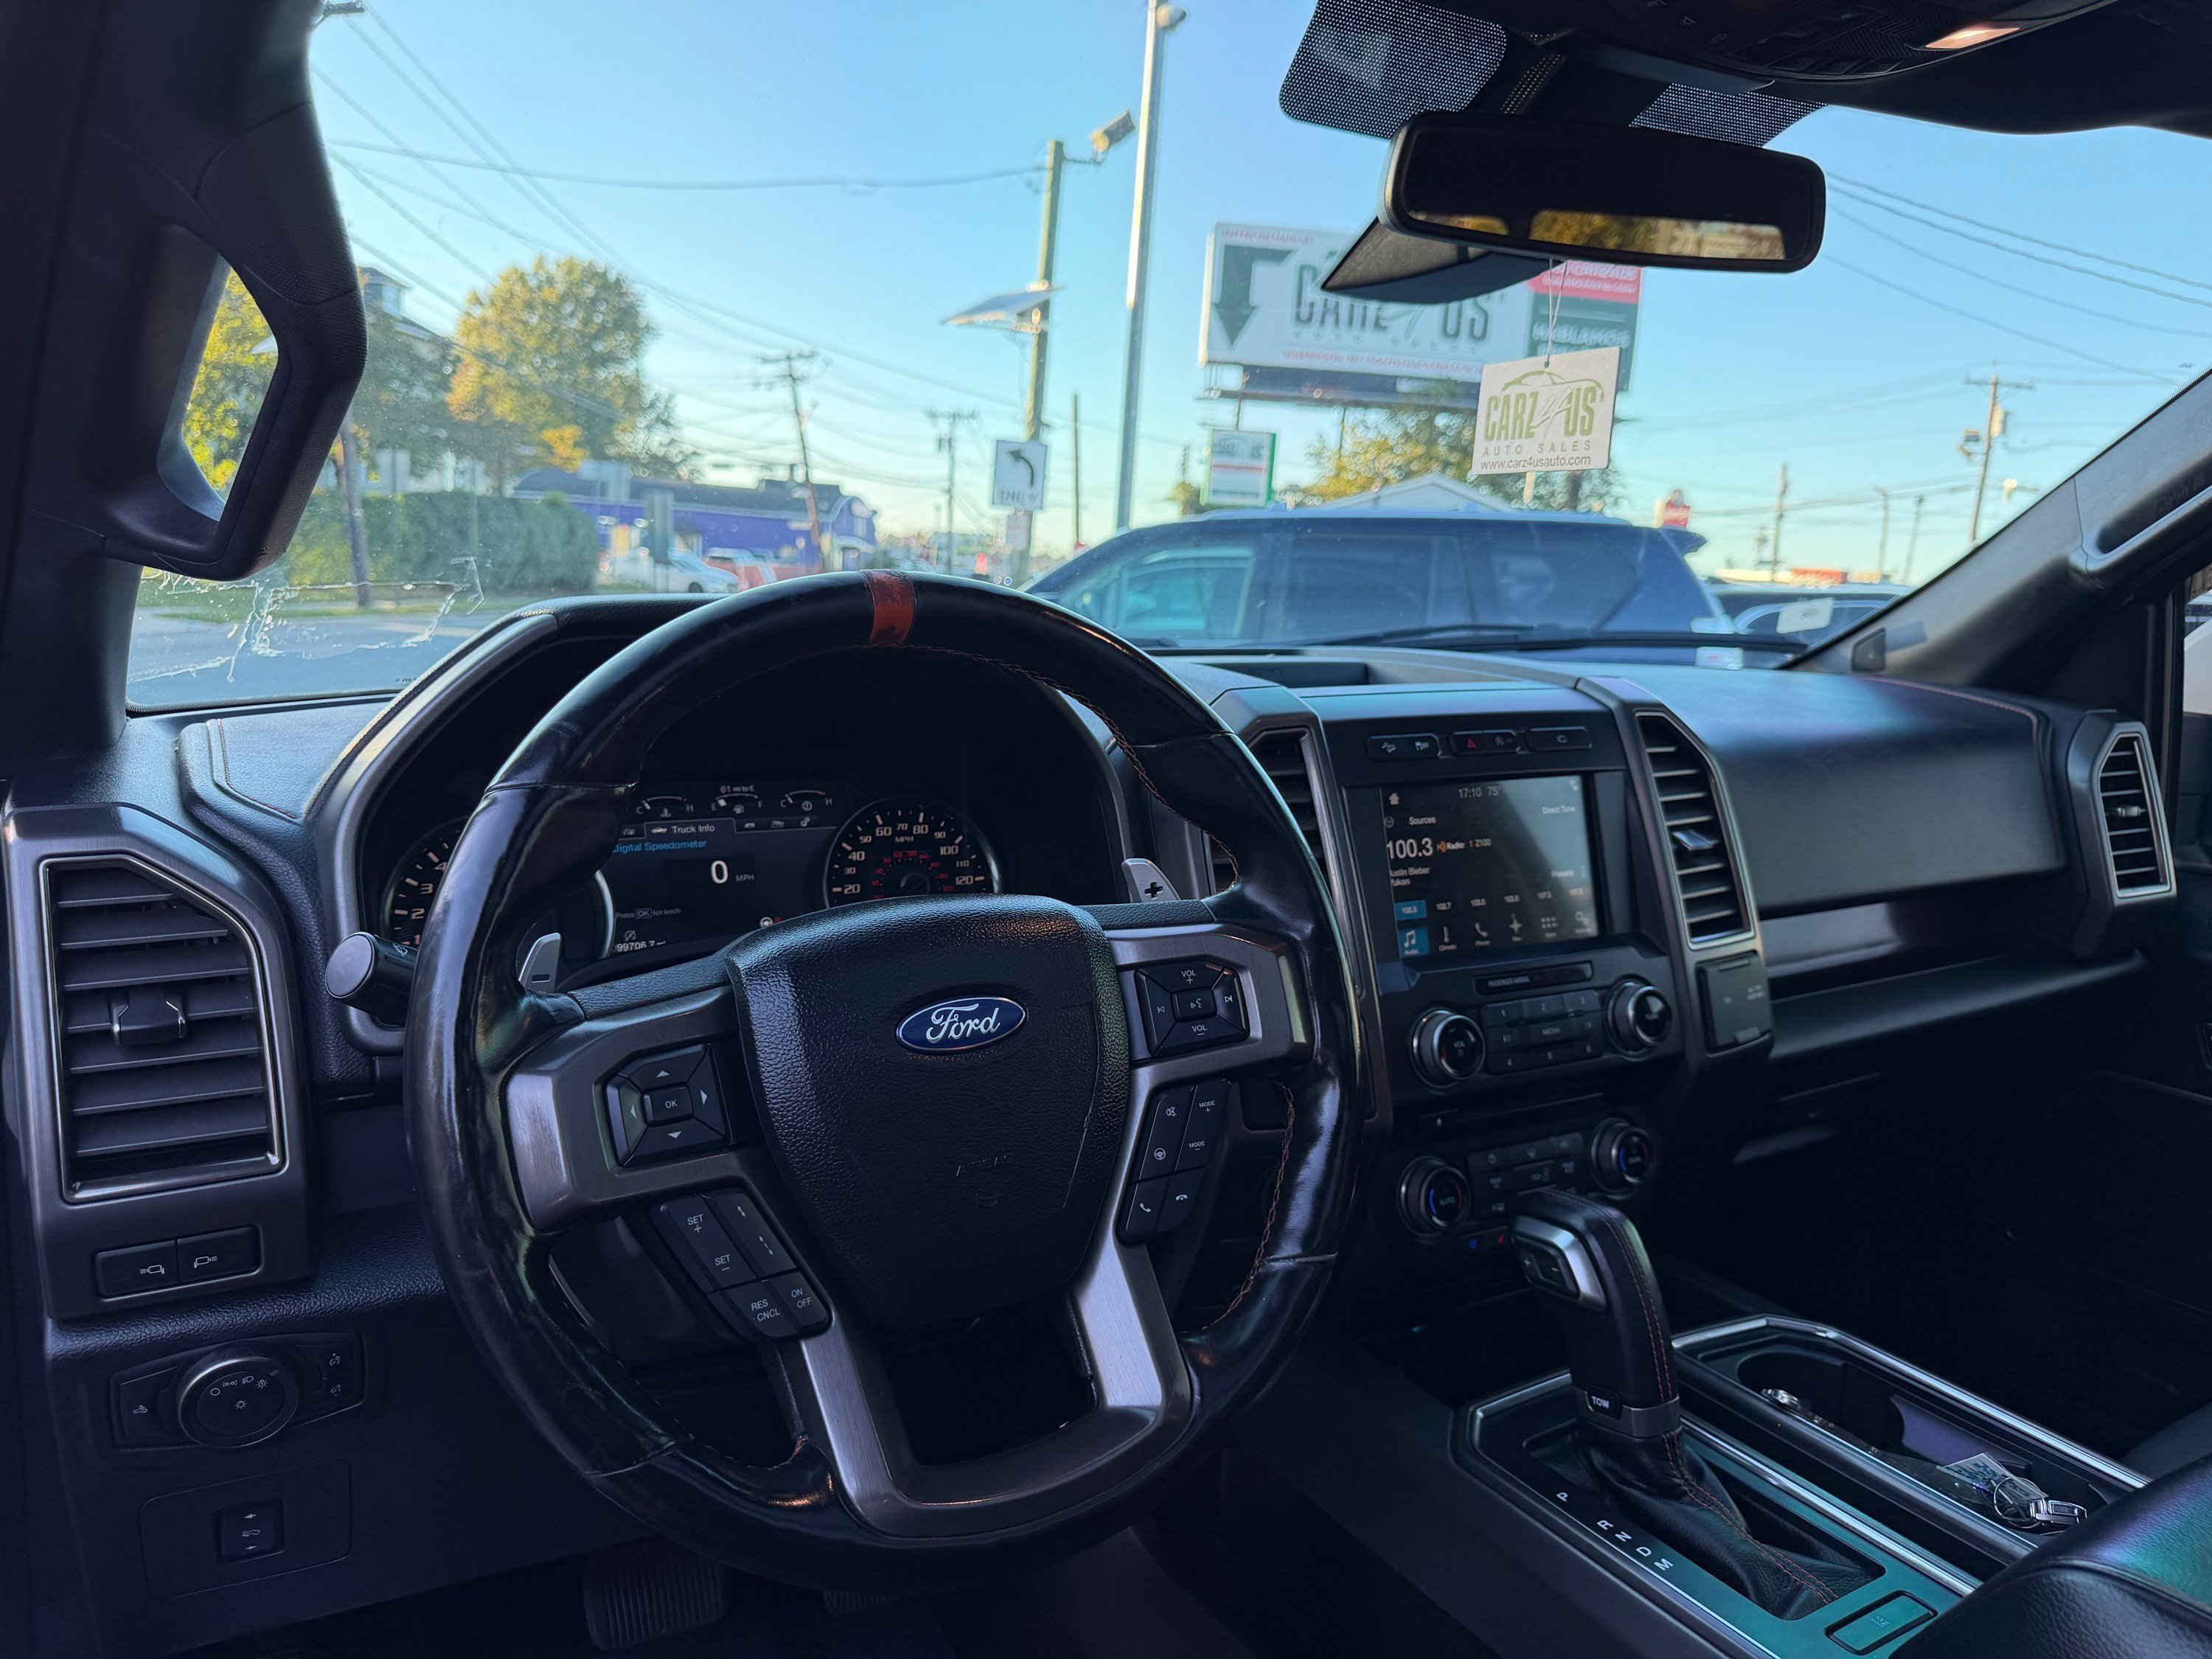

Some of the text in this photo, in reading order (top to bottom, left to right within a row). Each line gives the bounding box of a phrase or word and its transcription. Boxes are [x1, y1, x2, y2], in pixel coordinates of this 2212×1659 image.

[1482, 440, 1591, 458] AUTO SALES
[1480, 455, 1591, 471] www.carz4usauto.com
[1457, 787, 1482, 799] 17:10
[1408, 816, 1436, 826] Sources
[672, 824, 716, 834] Truck Info
[875, 827, 892, 836] 60
[913, 824, 929, 835] 80
[859, 835, 872, 844] 50
[644, 839, 708, 852] Speedometer
[939, 846, 959, 855] 100
[1386, 837, 1433, 860] 100.3
[849, 851, 866, 861] 40
[434, 862, 448, 872] 4
[710, 860, 755, 884] 0 MPH
[844, 867, 856, 875] 30
[956, 875, 974, 886] 120
[420, 883, 434, 894] 3
[844, 884, 860, 894] 20
[411, 908, 425, 919] 2
[664, 908, 682, 916] km/h
[1181, 970, 1197, 978] VOL
[926, 1004, 1001, 1043] Ford
[1192, 1024, 1208, 1032] VOL
[665, 1098, 678, 1109] OK
[1199, 1100, 1216, 1108] MODE
[1189, 1140, 1206, 1148] MODE
[687, 1214, 704, 1226] SET
[714, 1254, 731, 1267] SET
[791, 1287, 804, 1299] ON
[751, 1298, 768, 1312] RES
[796, 1297, 812, 1309] OFF
[757, 1308, 781, 1322] CNCL
[1591, 1395, 1610, 1409] TOW
[1556, 1491, 1569, 1503] P
[1596, 1520, 1614, 1531] R
[1615, 1531, 1632, 1543] N
[1635, 1546, 1652, 1557] D
[1654, 1558, 1674, 1571] M
